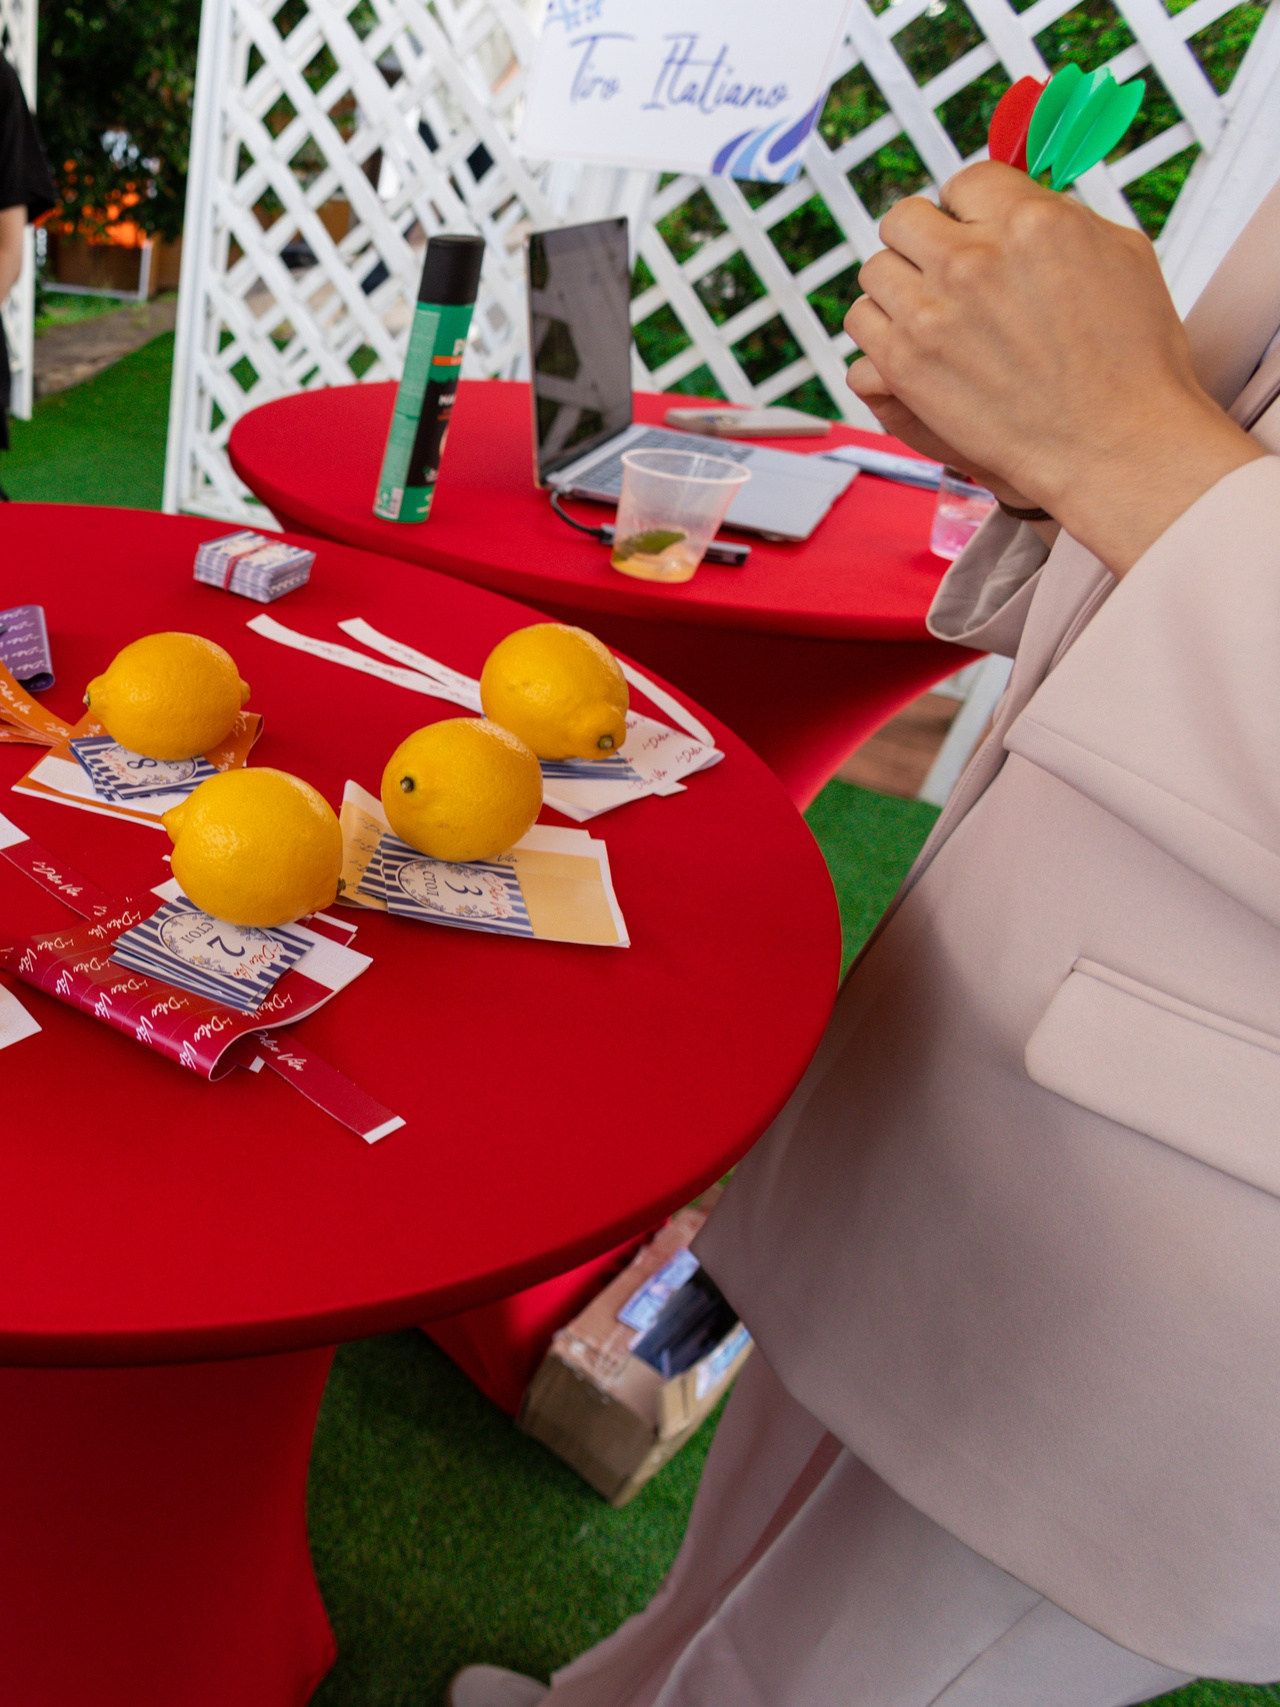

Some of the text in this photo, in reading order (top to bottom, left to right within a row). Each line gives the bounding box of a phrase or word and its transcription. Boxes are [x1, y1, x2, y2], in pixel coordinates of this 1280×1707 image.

[569, 32, 636, 106] Tiro
[127, 757, 158, 769] 8
[444, 880, 483, 896] 3
[180, 922, 214, 944] СТОЛ
[206, 935, 246, 957] 2
